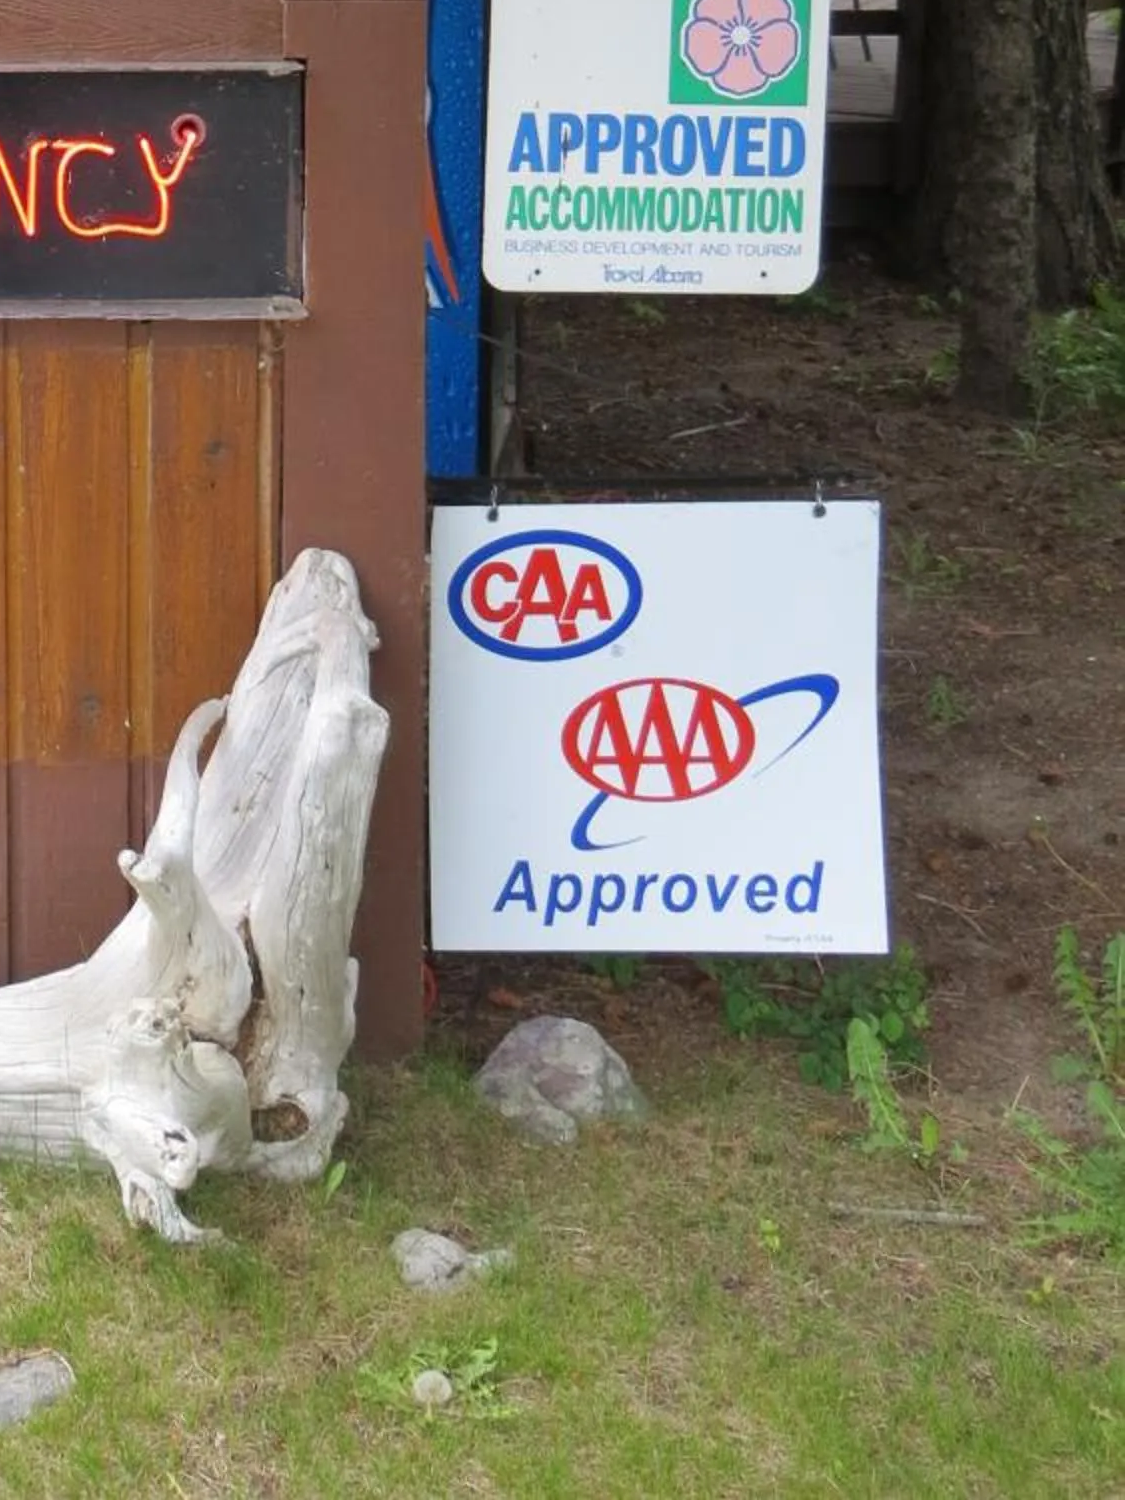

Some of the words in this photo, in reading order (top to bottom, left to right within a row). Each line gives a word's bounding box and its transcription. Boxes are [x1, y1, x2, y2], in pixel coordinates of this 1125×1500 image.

[507, 112, 806, 177] APPROVED
[504, 185, 804, 234] ACCOMMODATION
[503, 239, 578, 255] BUSINESS
[582, 240, 694, 257] DEVELOPMENT
[699, 242, 731, 257] AND
[736, 242, 803, 257] TOURISM
[603, 264, 645, 283] Travel
[649, 264, 703, 285] Alberta
[470, 548, 612, 643] CAA
[584, 679, 734, 799] AAA
[493, 860, 825, 926] Approved
